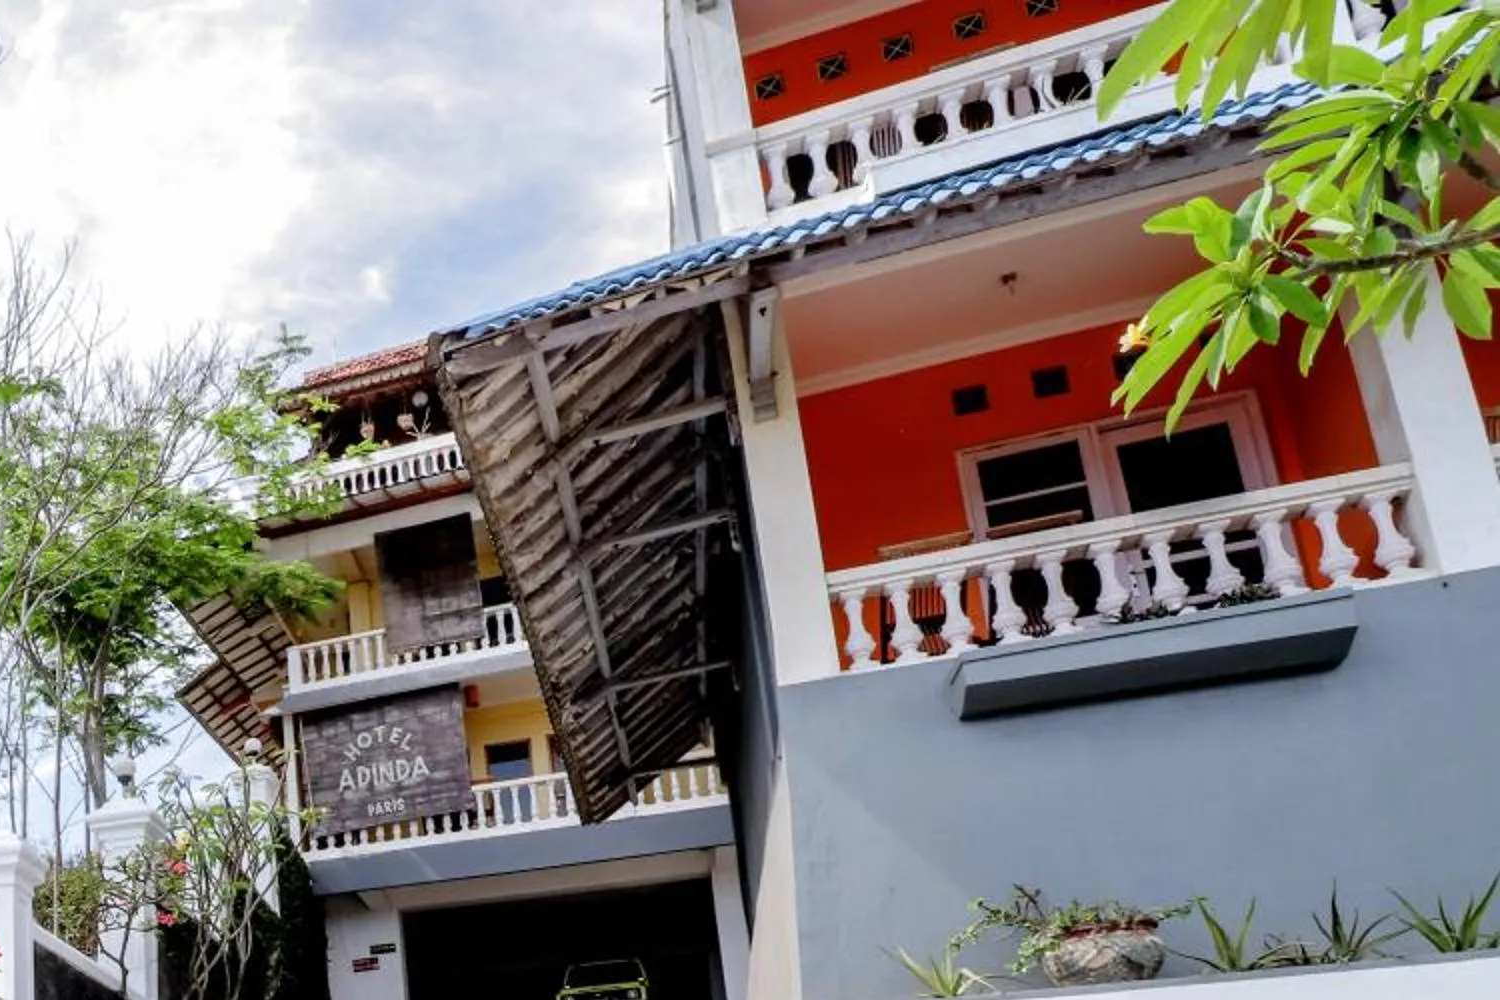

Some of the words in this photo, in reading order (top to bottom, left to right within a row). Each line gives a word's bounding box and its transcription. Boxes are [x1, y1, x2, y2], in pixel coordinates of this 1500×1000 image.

[343, 726, 413, 761] HOTEL
[339, 756, 429, 792] ADINDA
[368, 799, 405, 816] PARIS
